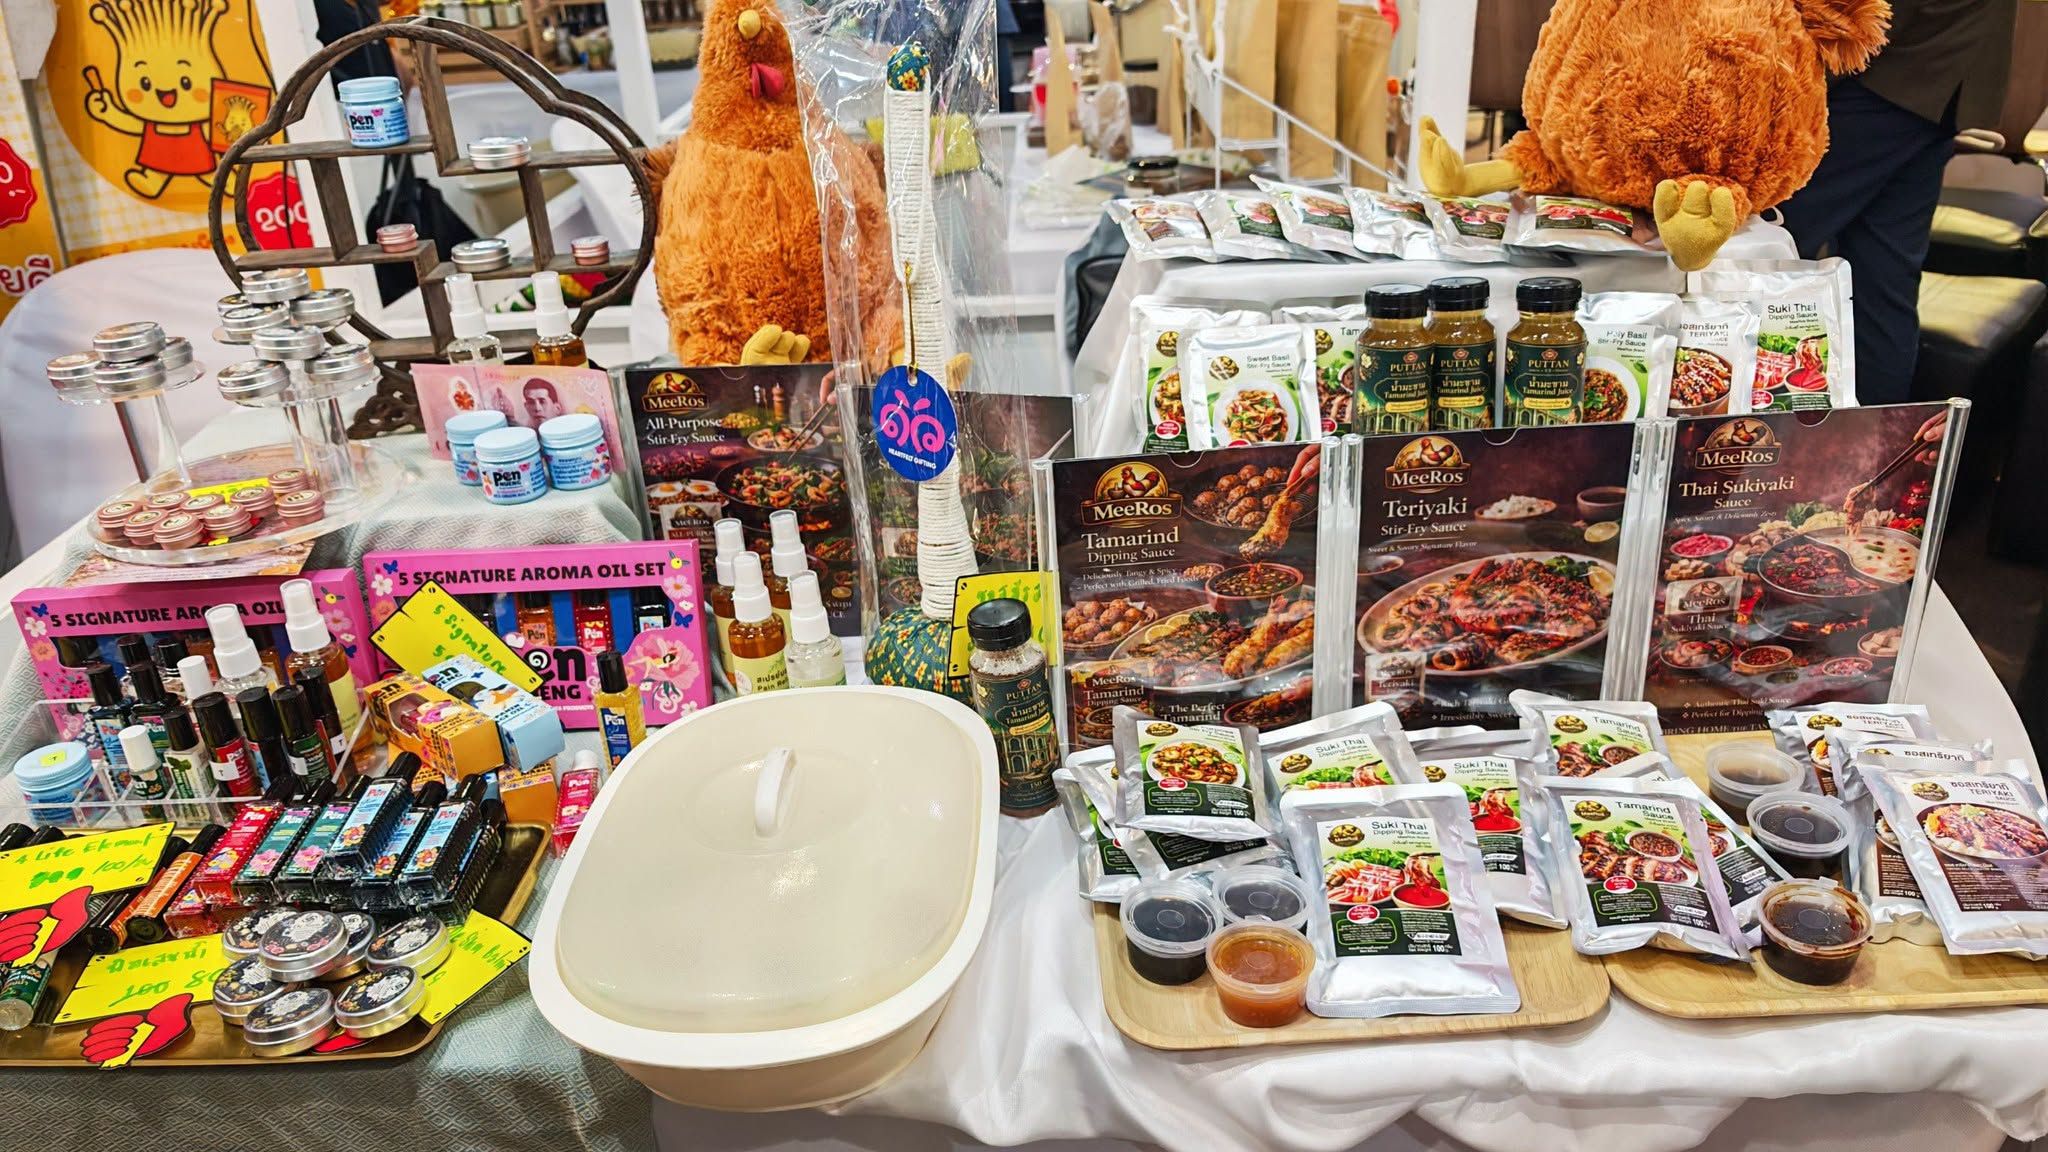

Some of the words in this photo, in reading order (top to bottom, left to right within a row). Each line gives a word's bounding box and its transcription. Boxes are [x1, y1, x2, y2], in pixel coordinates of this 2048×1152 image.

[1768, 304, 1790, 313] Suki
[1794, 302, 1816, 312] Thai
[1627, 331, 1648, 339] Basil
[1625, 339, 1646, 347] Sauce
[1390, 361, 1427, 372] PUTTAN
[1441, 358, 1480, 368] PUTTAN
[1528, 360, 1569, 368] PUTTAN
[649, 395, 705, 410] MeeRos
[646, 416, 723, 431] All-Purpose
[647, 433, 689, 446] Stir-Fry
[691, 433, 725, 443] Sauce
[888, 447, 914, 463] HEARTFELT
[914, 456, 937, 470] GIFTING
[1700, 451, 1773, 467] MeeRos
[1392, 470, 1464, 487] MeeRos
[1679, 481, 1718, 497] Thai
[1722, 476, 1795, 497] Sukiyaki
[1383, 497, 1468, 521] Teriyaki
[1714, 497, 1752, 509] Sauce
[1093, 500, 1173, 521] MeeRos
[1381, 523, 1427, 536] Stir-Fry
[1430, 521, 1467, 533] Sauce
[1081, 526, 1180, 550] Tamarind
[1087, 550, 1138, 565] Dipping
[1141, 546, 1176, 559] Sauce
[399, 571, 409, 586] 5
[413, 567, 516, 586] SIGNATURE
[521, 565, 592, 581] AROMA
[597, 563, 631, 578] OIL
[635, 562, 667, 577] SET
[1083, 571, 1122, 581] Deliciously
[1083, 582, 1108, 591] Perfect
[1110, 581, 1126, 589] with
[51, 614, 62, 628] 5
[66, 607, 171, 627] SIGNATURE
[176, 604, 249, 622] AROA
[1688, 613, 1716, 624] Thai
[1092, 676, 1136, 687] MeeRos
[1006, 683, 1042, 701] PUTTAN
[1084, 685, 1145, 700] Tamarind
[1169, 704, 1188, 713] The
[1191, 702, 1225, 714] Perfect
[1161, 712, 1221, 723] Tamarind
[1690, 711, 1717, 719] Perfect
[1592, 716, 1641, 732] Tamarind
[1315, 741, 1340, 754] Suki
[1342, 738, 1366, 748] Thai
[1453, 761, 1480, 770] Suki
[1483, 760, 1508, 769] Thai
[1970, 788, 2014, 798] TERIYAKI
[1616, 801, 1671, 814] Tamarind
[1643, 810, 1675, 820] Sauce
[1371, 821, 1399, 830] Suki
[1402, 821, 1427, 830] Thai
[1432, 944, 1445, 953] 100
